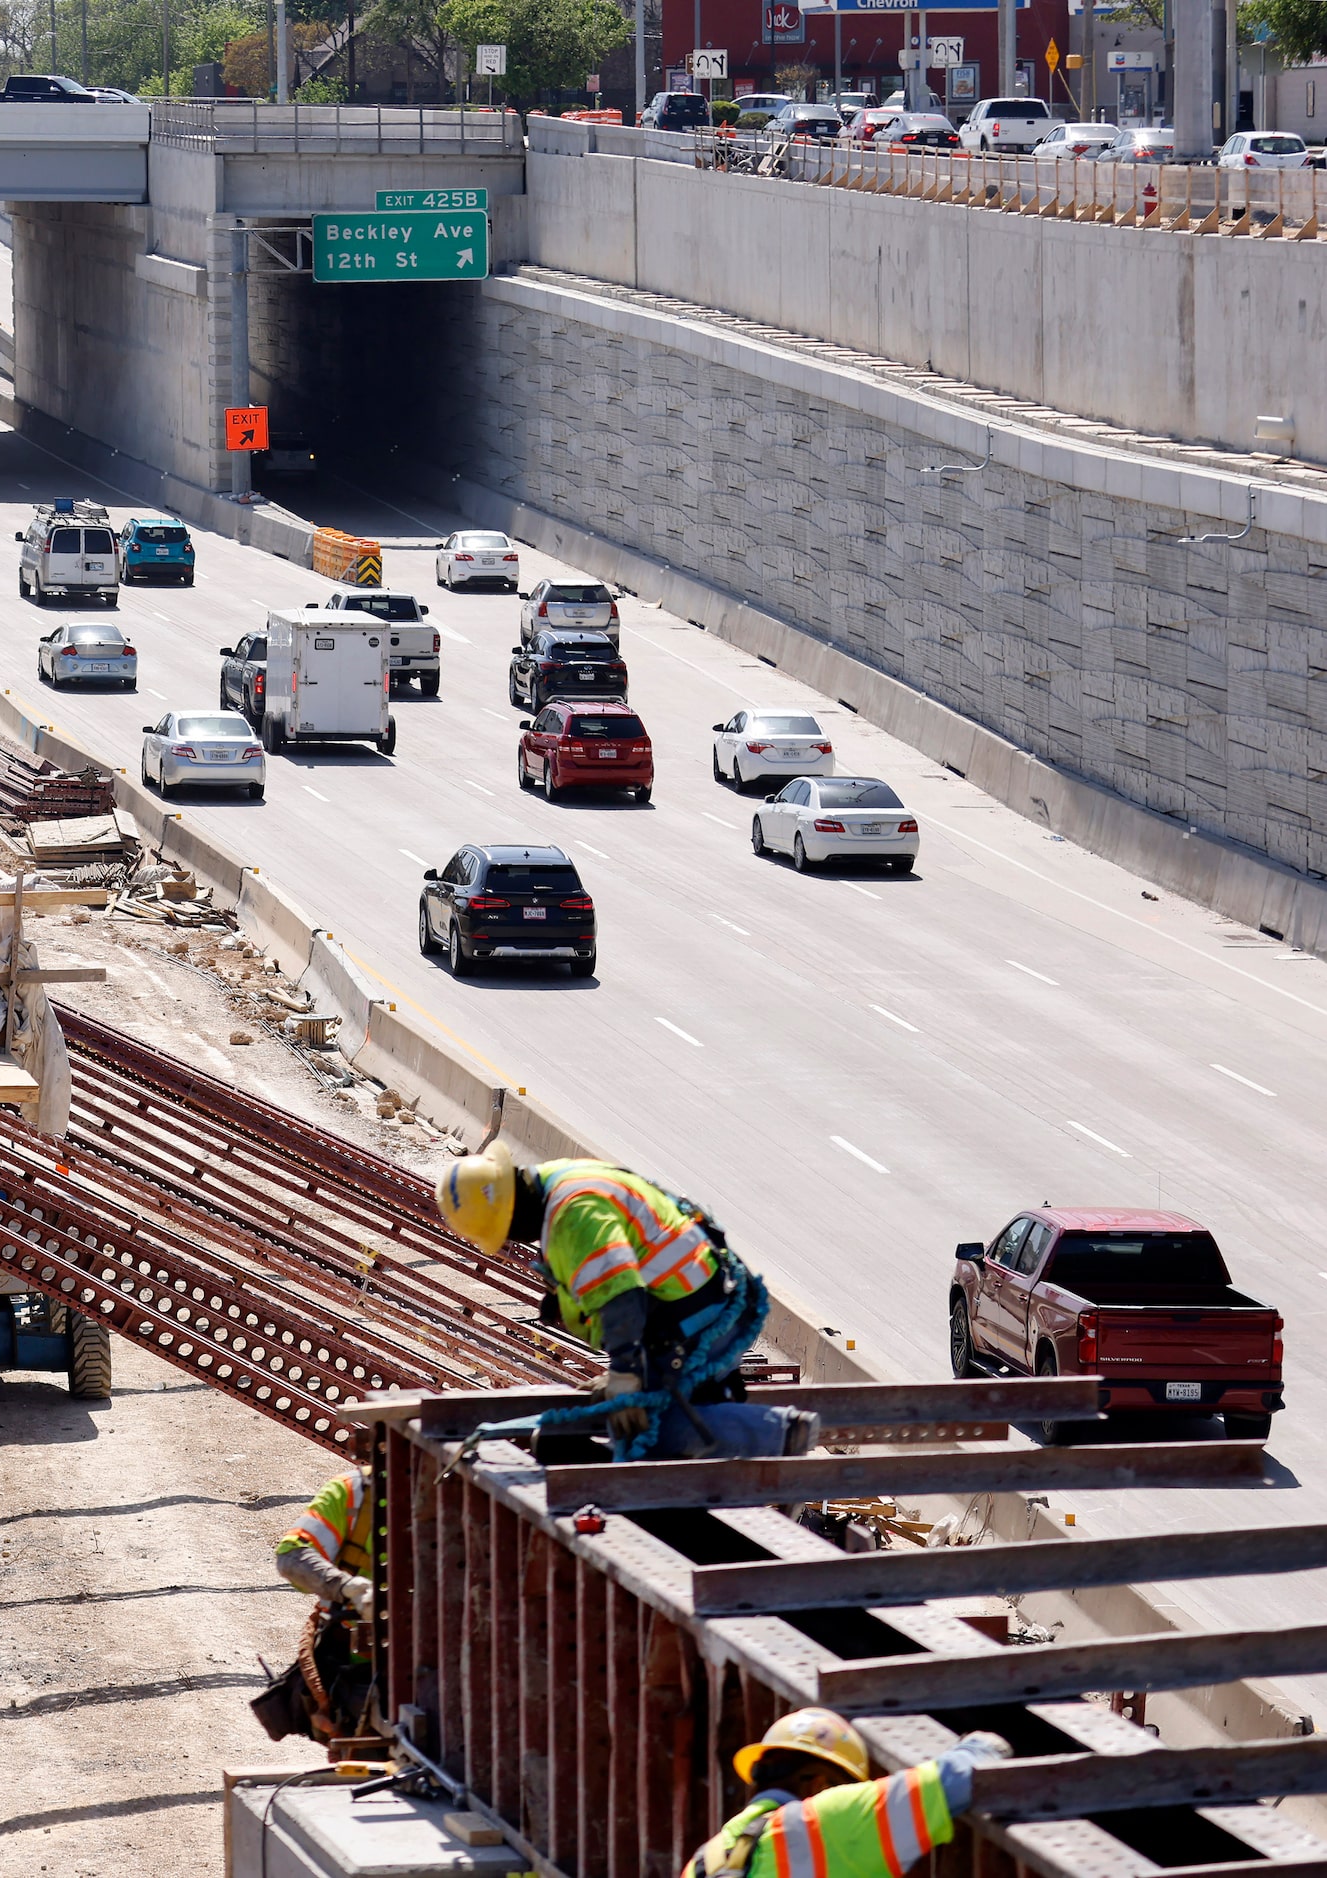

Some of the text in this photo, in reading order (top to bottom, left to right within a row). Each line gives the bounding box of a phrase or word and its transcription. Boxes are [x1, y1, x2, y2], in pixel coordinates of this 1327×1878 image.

[385, 192, 478, 208] EXIT 425B
[326, 223, 473, 243] Beckley Ave
[327, 251, 418, 269] 12th St
[232, 413, 260, 425] EXIT
